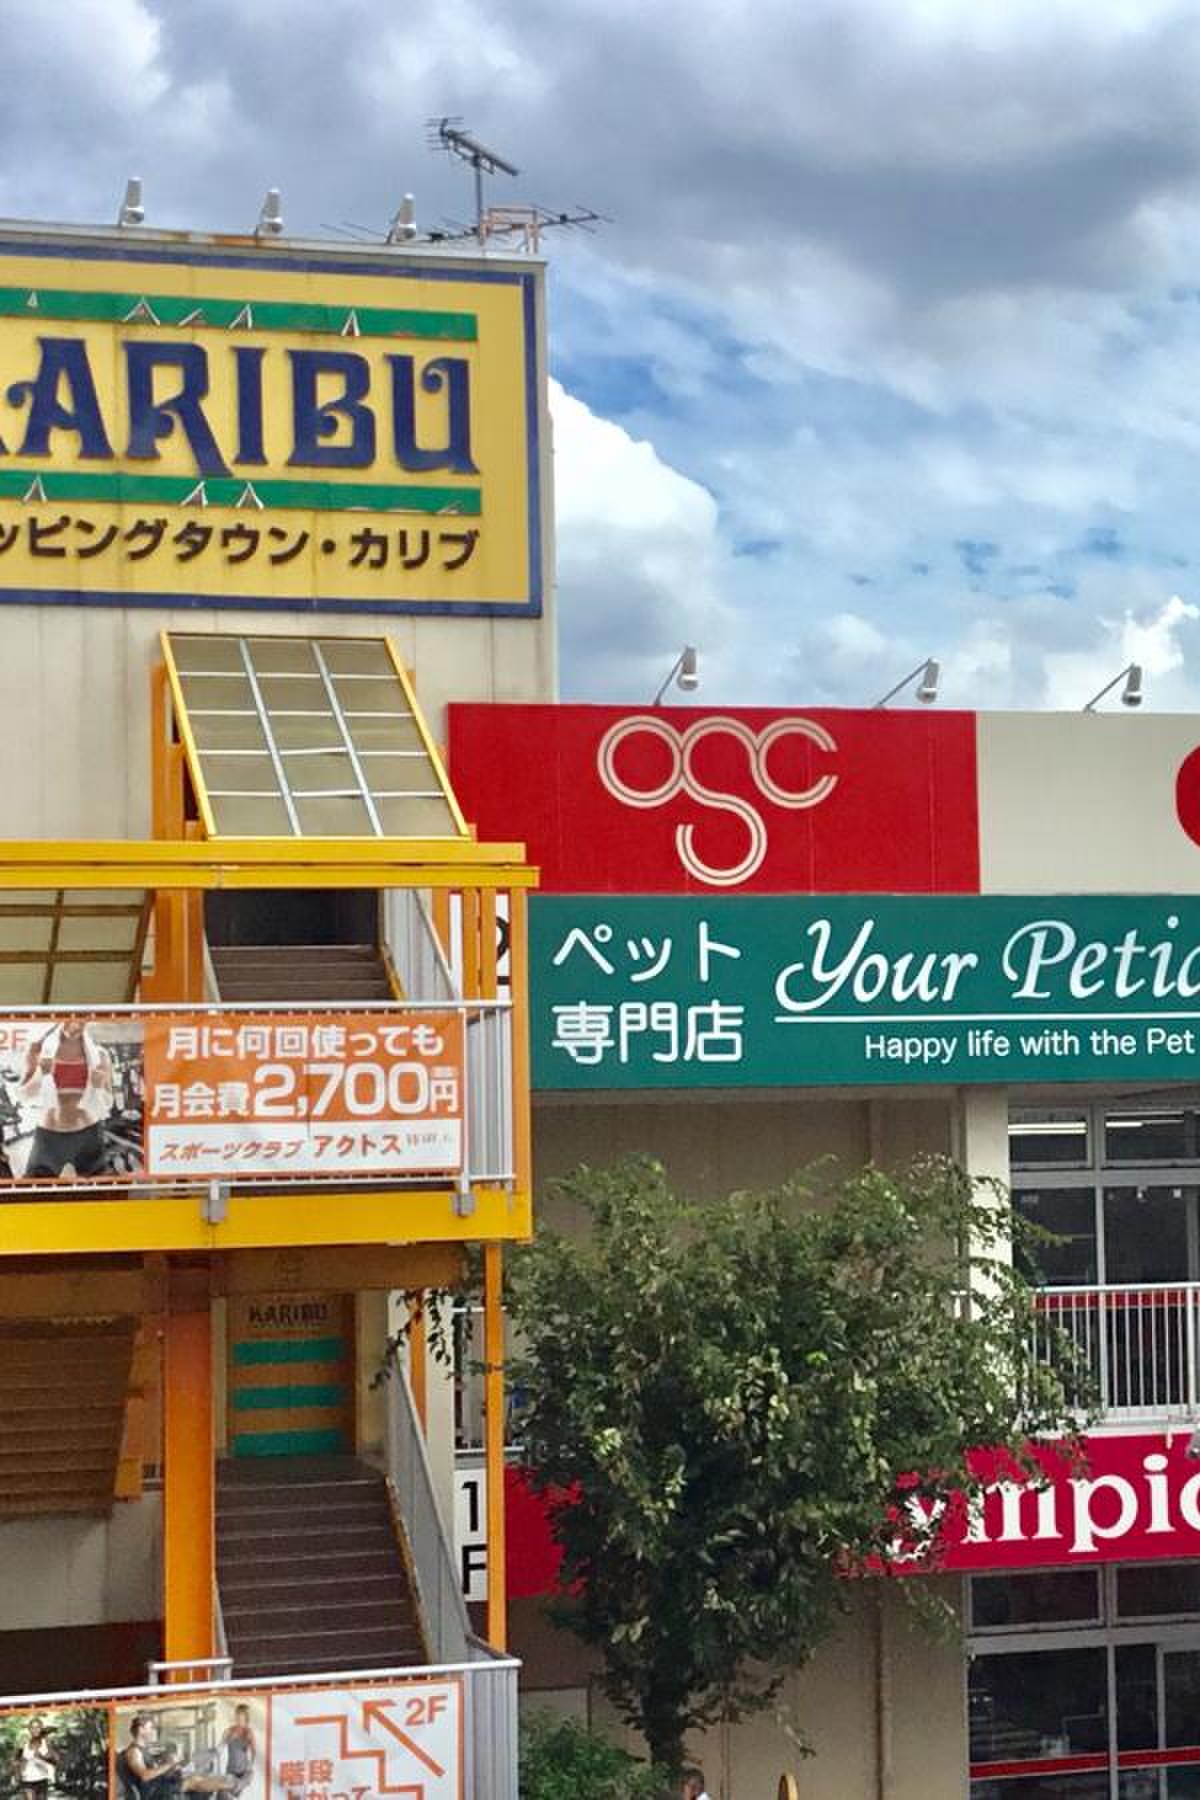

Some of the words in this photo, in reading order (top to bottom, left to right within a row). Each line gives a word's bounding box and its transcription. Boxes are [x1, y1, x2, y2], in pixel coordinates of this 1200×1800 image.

[0, 337, 480, 477] ARIBU
[552, 921, 742, 984] ペット
[775, 919, 978, 1012] Your
[166, 1025, 444, 1061] 月に何回使っても
[551, 1001, 745, 1065] 専門店
[865, 1033, 957, 1064] Happy
[967, 1030, 1010, 1058] life
[1019, 1029, 1078, 1057] with
[1089, 1029, 1136, 1056] the
[1147, 1028, 1195, 1055] Pet
[312, 1132, 402, 1158] アクトス
[405, 1695, 449, 1727] 2F
[279, 1758, 334, 1788] 階段
